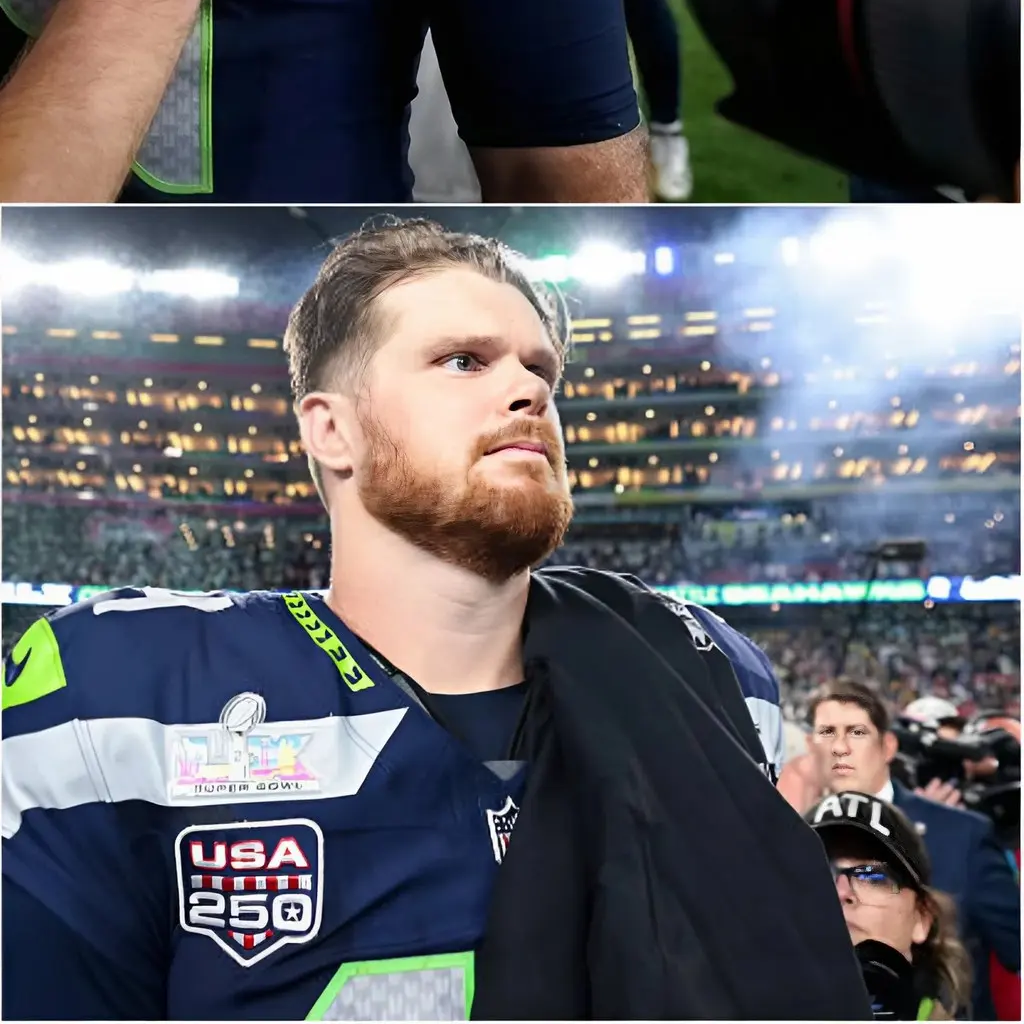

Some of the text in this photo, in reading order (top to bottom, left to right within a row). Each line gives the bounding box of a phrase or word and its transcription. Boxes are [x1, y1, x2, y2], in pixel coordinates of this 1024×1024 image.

[814, 793, 890, 837] ATL
[189, 836, 311, 871] USA
[189, 891, 313, 932] 250
